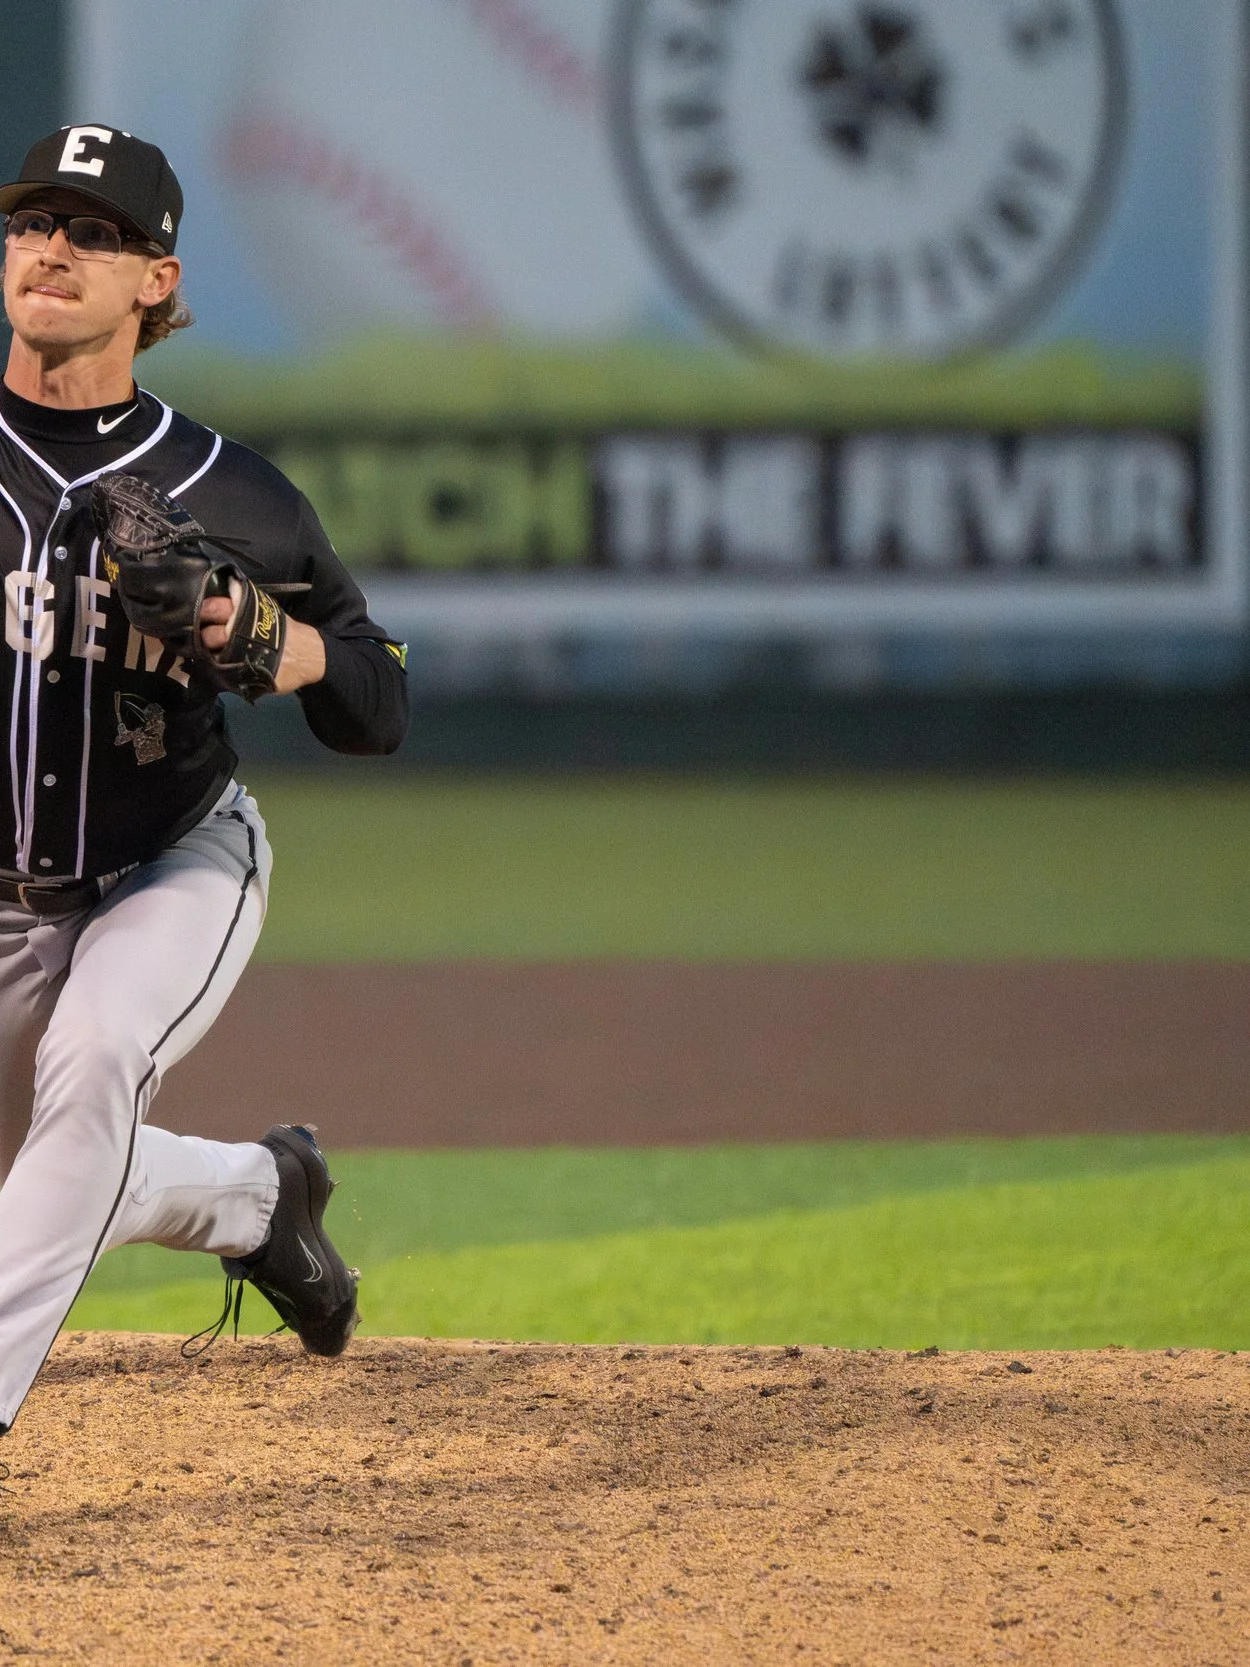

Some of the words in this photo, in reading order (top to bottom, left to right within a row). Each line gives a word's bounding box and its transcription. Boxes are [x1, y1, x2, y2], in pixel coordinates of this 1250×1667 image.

[57, 126, 112, 177] E
[774, 128, 1068, 328] LOTTERY
[600, 437, 818, 566] THE
[840, 437, 1192, 566] FEVER
